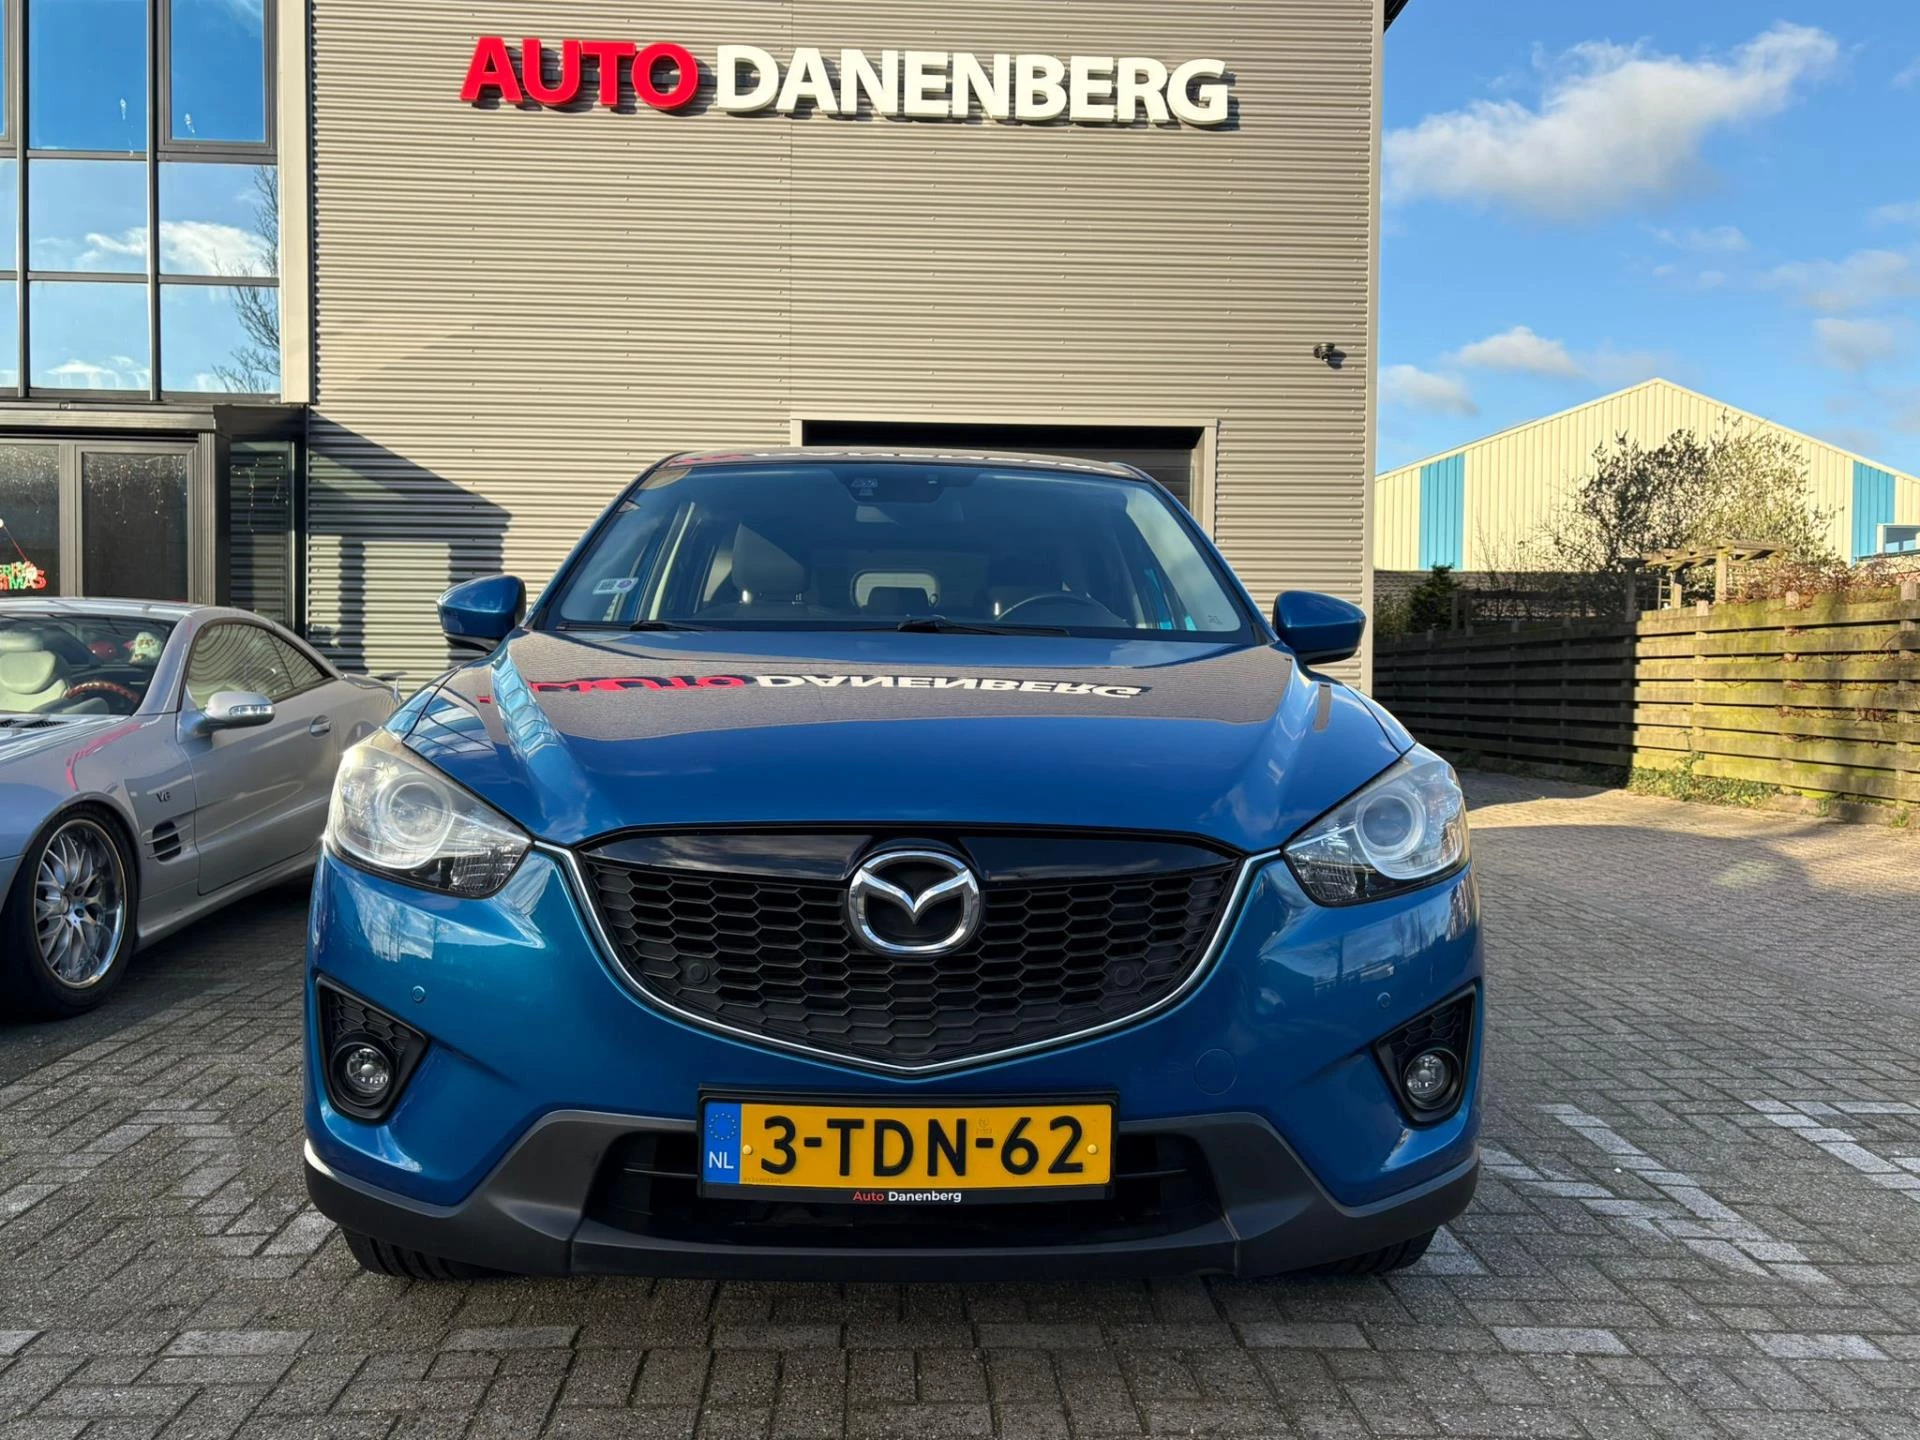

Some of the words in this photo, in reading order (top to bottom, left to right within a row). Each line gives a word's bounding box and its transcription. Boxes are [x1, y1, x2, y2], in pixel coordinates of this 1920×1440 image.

[460, 36, 699, 110] AUTO
[716, 44, 1229, 125] DANENBERG
[708, 1151, 735, 1169] NL
[761, 1115, 1083, 1176] 3-TDN-62
[853, 1191, 885, 1201] Auto
[888, 1190, 962, 1203] Danenberg
